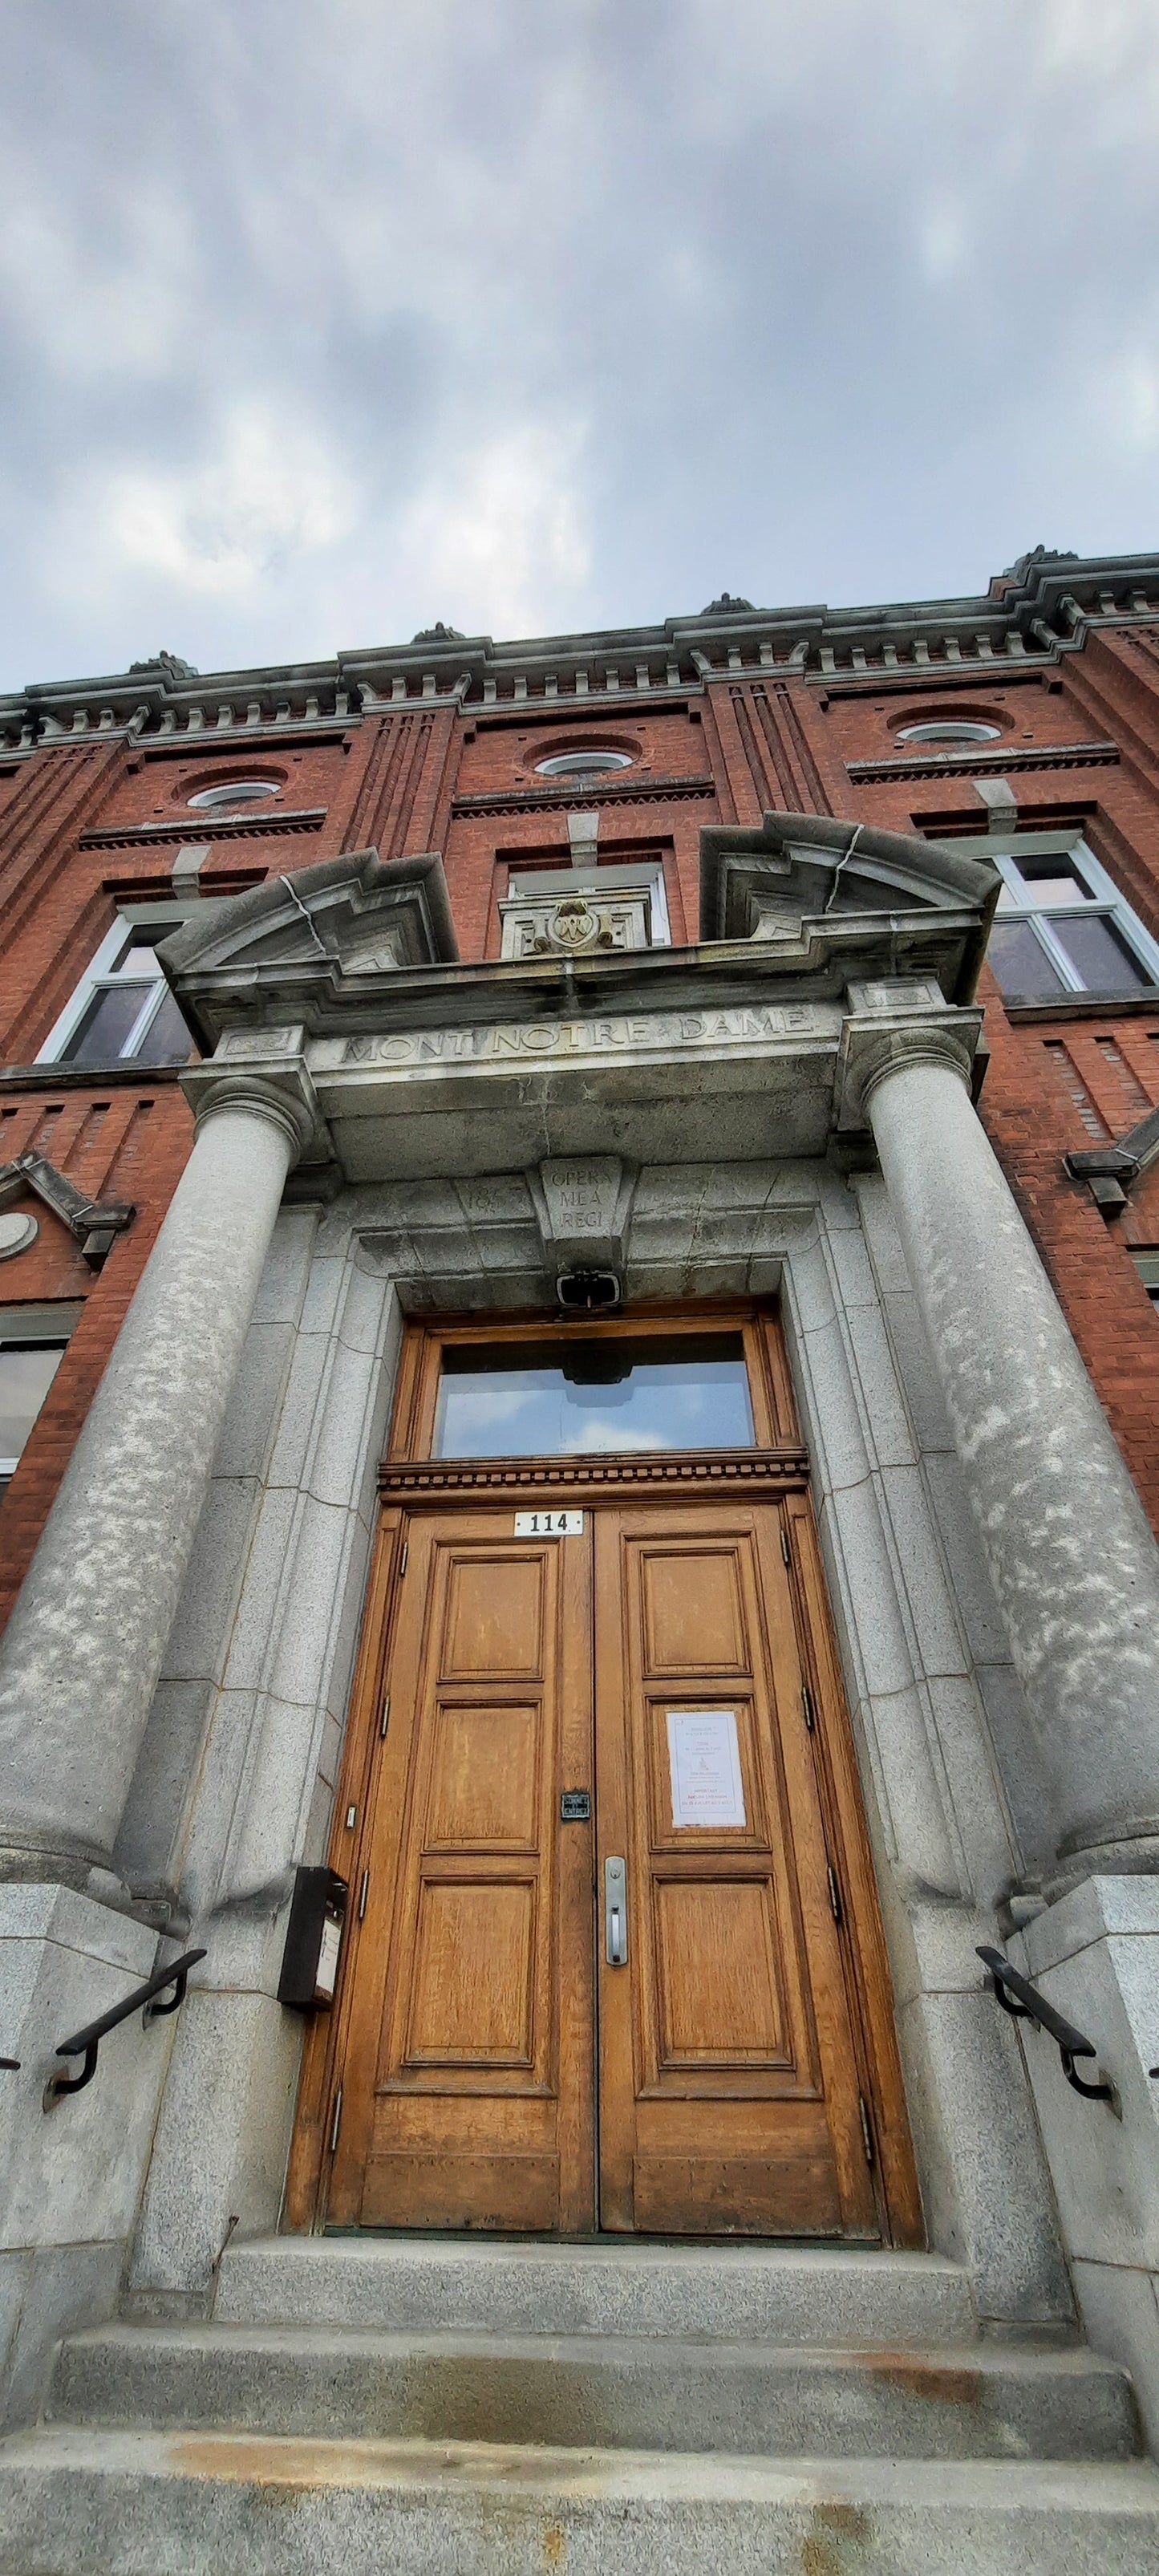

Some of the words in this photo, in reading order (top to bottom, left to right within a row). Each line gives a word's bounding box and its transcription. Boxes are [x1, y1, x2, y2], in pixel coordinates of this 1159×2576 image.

[340, 1030, 474, 1063] MONT
[492, 1019, 650, 1053] NOTRE
[679, 1008, 814, 1040] DAME
[552, 1170, 613, 1187] OPERA
[560, 1190, 602, 1207] MEA
[560, 1211, 602, 1228] REGI
[530, 1513, 568, 1532] 114
